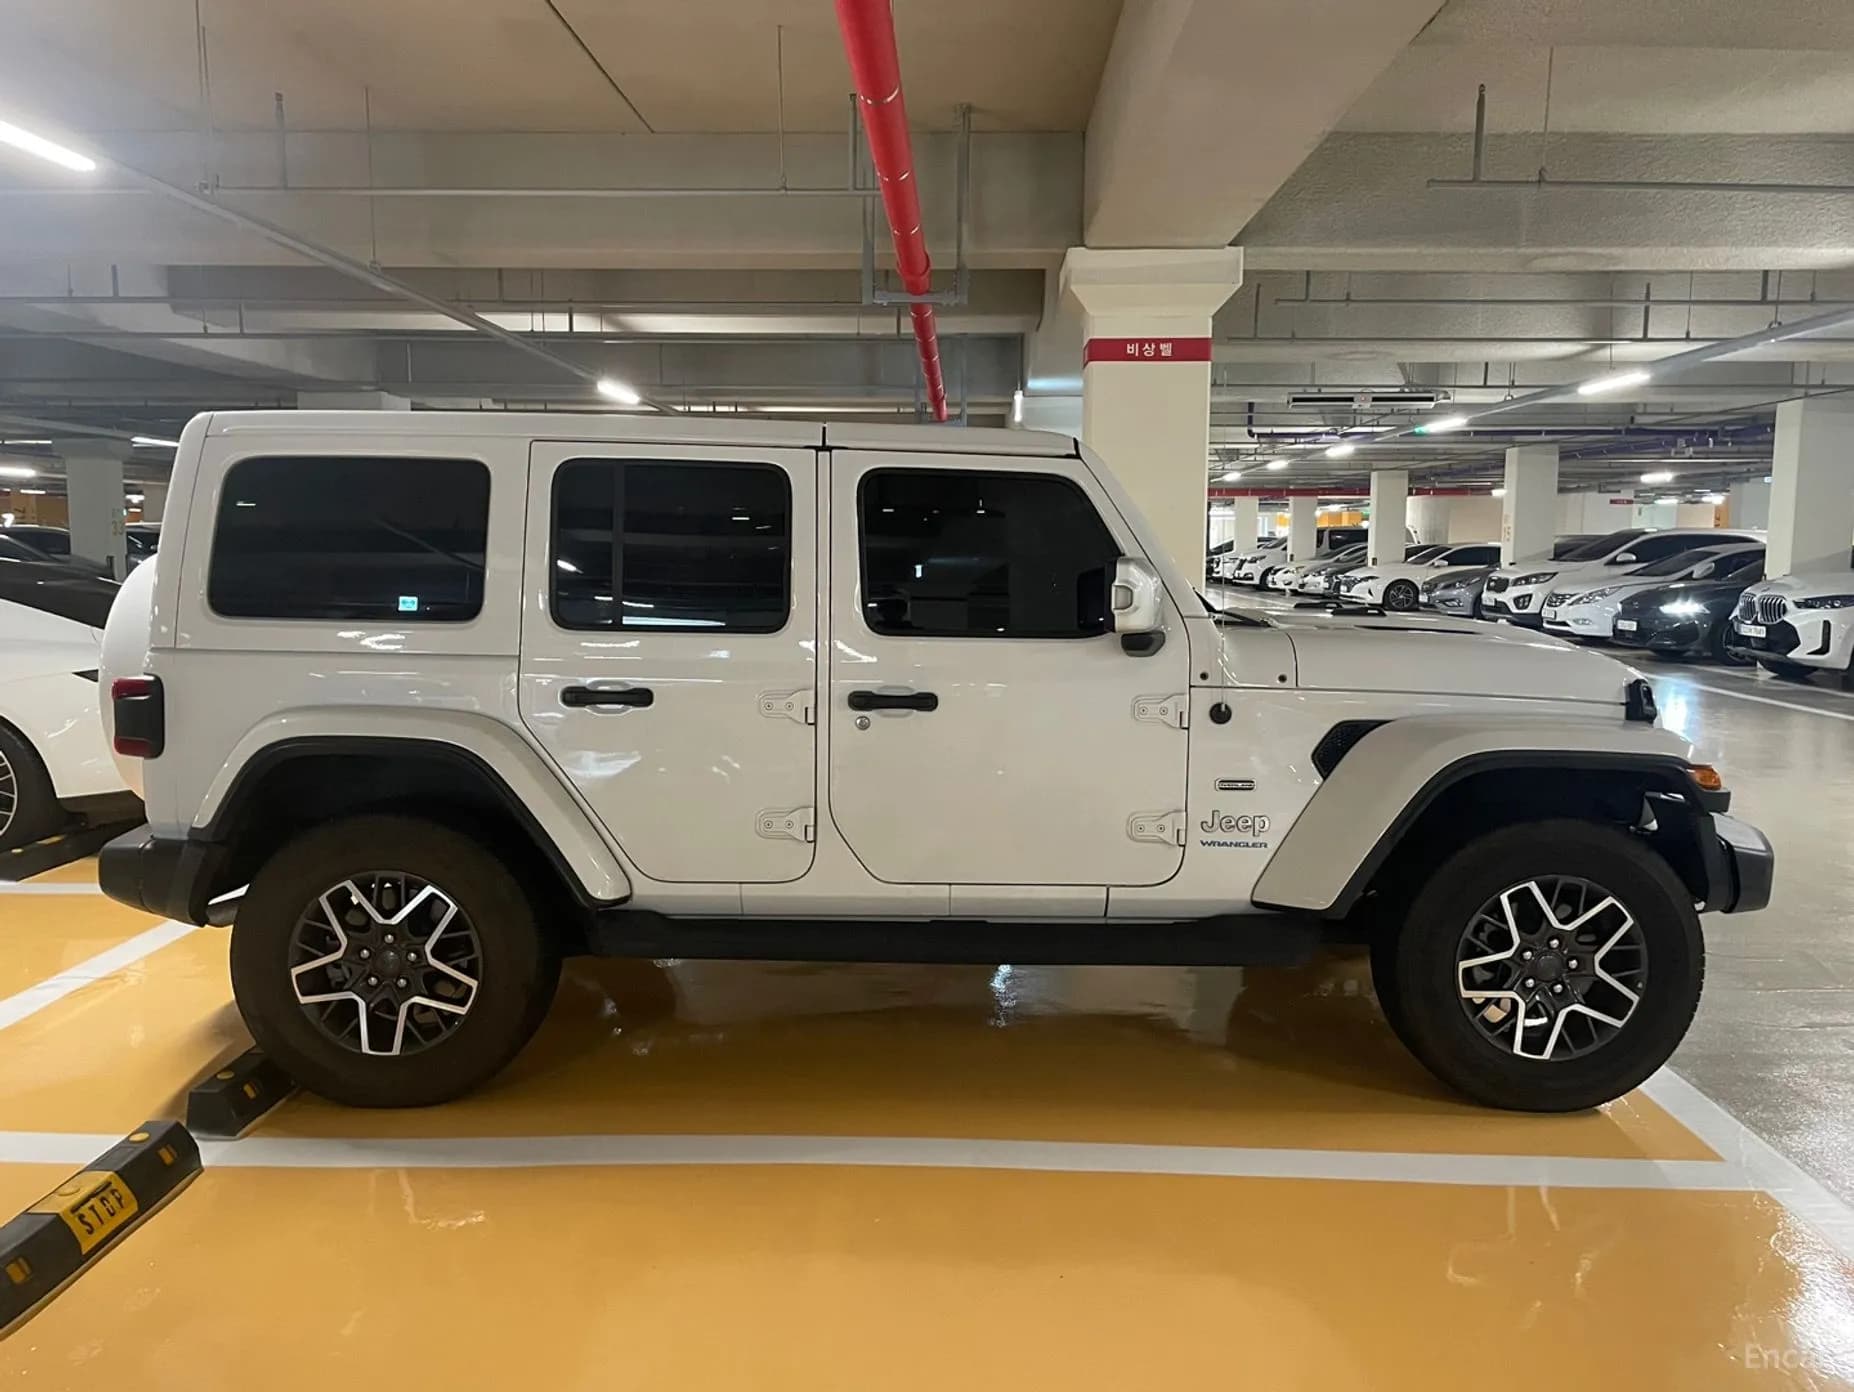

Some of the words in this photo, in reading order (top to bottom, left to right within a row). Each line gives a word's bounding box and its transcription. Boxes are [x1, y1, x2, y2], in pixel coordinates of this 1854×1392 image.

[1126, 342, 1172, 357] 비상벨
[1200, 809, 1271, 837] Jeep
[1200, 839, 1268, 849] WRANGLER
[77, 1188, 125, 1235] STOP
